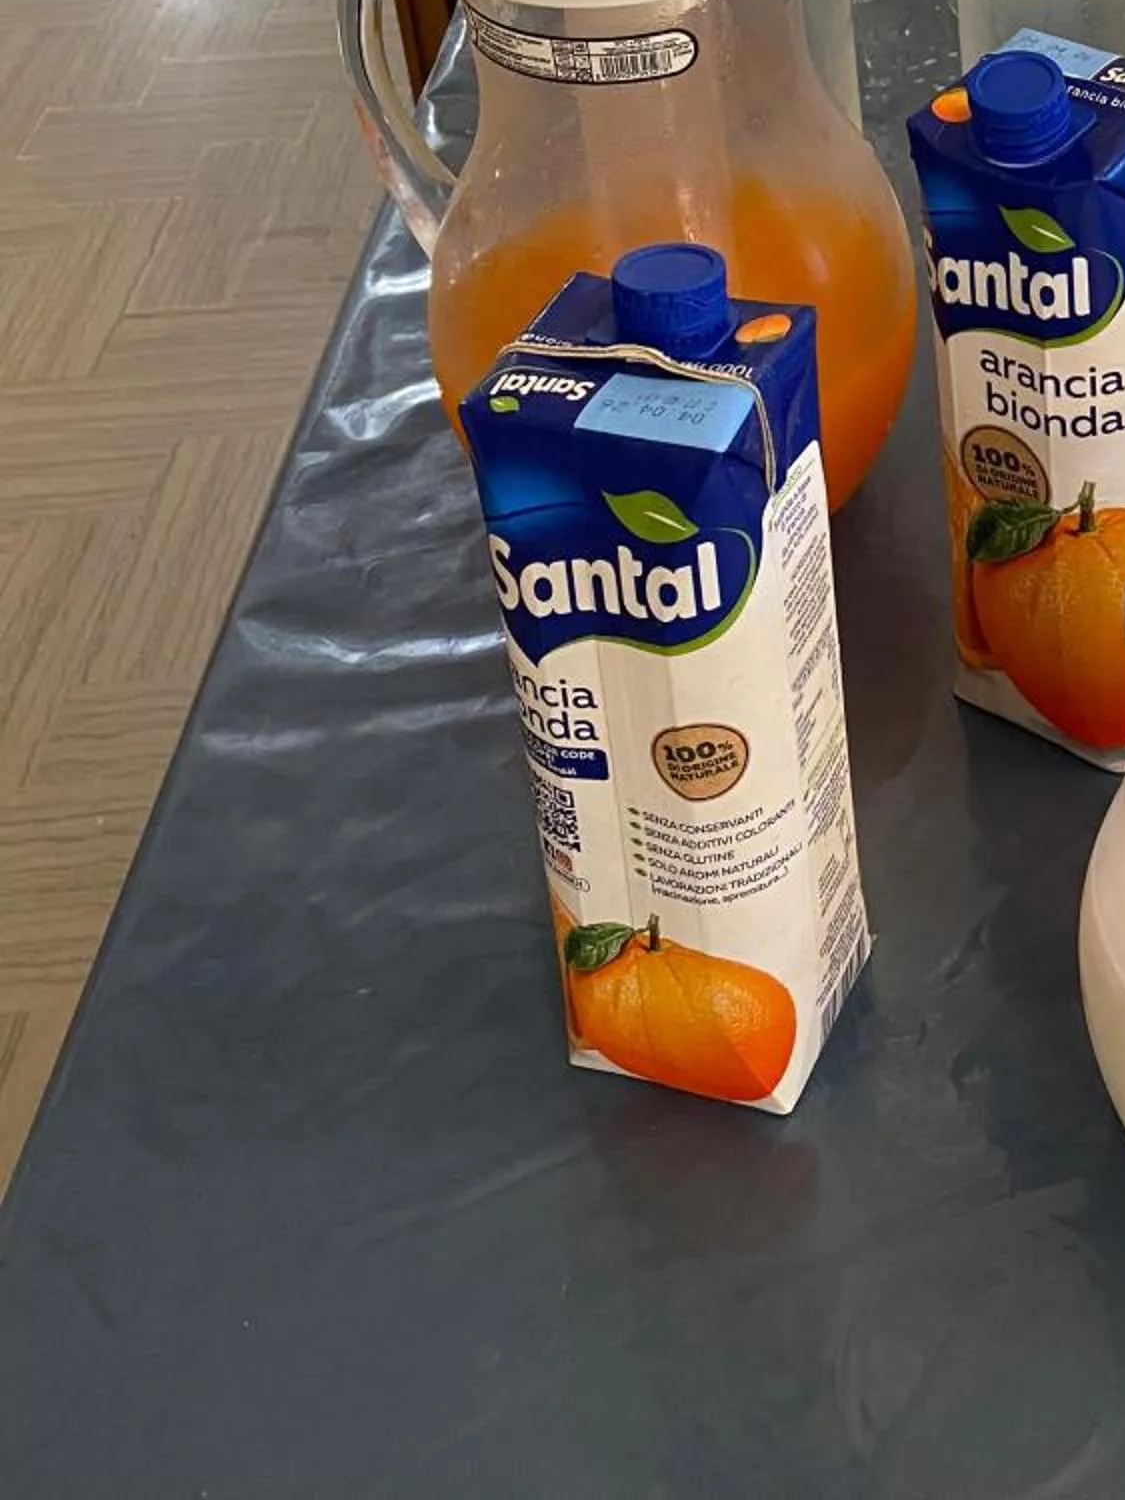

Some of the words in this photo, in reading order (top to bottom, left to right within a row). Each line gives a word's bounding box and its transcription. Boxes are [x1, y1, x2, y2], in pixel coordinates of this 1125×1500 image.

[1065, 84, 1108, 105] rancia
[489, 373, 597, 401] Santal
[979, 349, 1125, 399] arancia
[986, 381, 1125, 438] bionda
[972, 444, 1036, 477] 100%
[488, 533, 721, 623] Santal
[663, 739, 734, 762] 100%
[681, 751, 737, 773] ORIGINE
[669, 760, 739, 781] NATURALE
[642, 811, 677, 830] SENZA
[679, 807, 764, 835] CONSERVANTI
[644, 826, 679, 847] SENZA
[681, 836, 733, 850] ADDITIVI
[735, 798, 796, 843] COLORANTI
[645, 841, 682, 861] SENZA
[683, 850, 736, 865] GLUTINE
[647, 857, 679, 875] SOLO
[679, 865, 720, 881] AROMI
[721, 844, 780, 877] NATURALI
[649, 874, 729, 895] LAVORAZIONI
[729, 842, 803, 891] TRADIZIONALI
